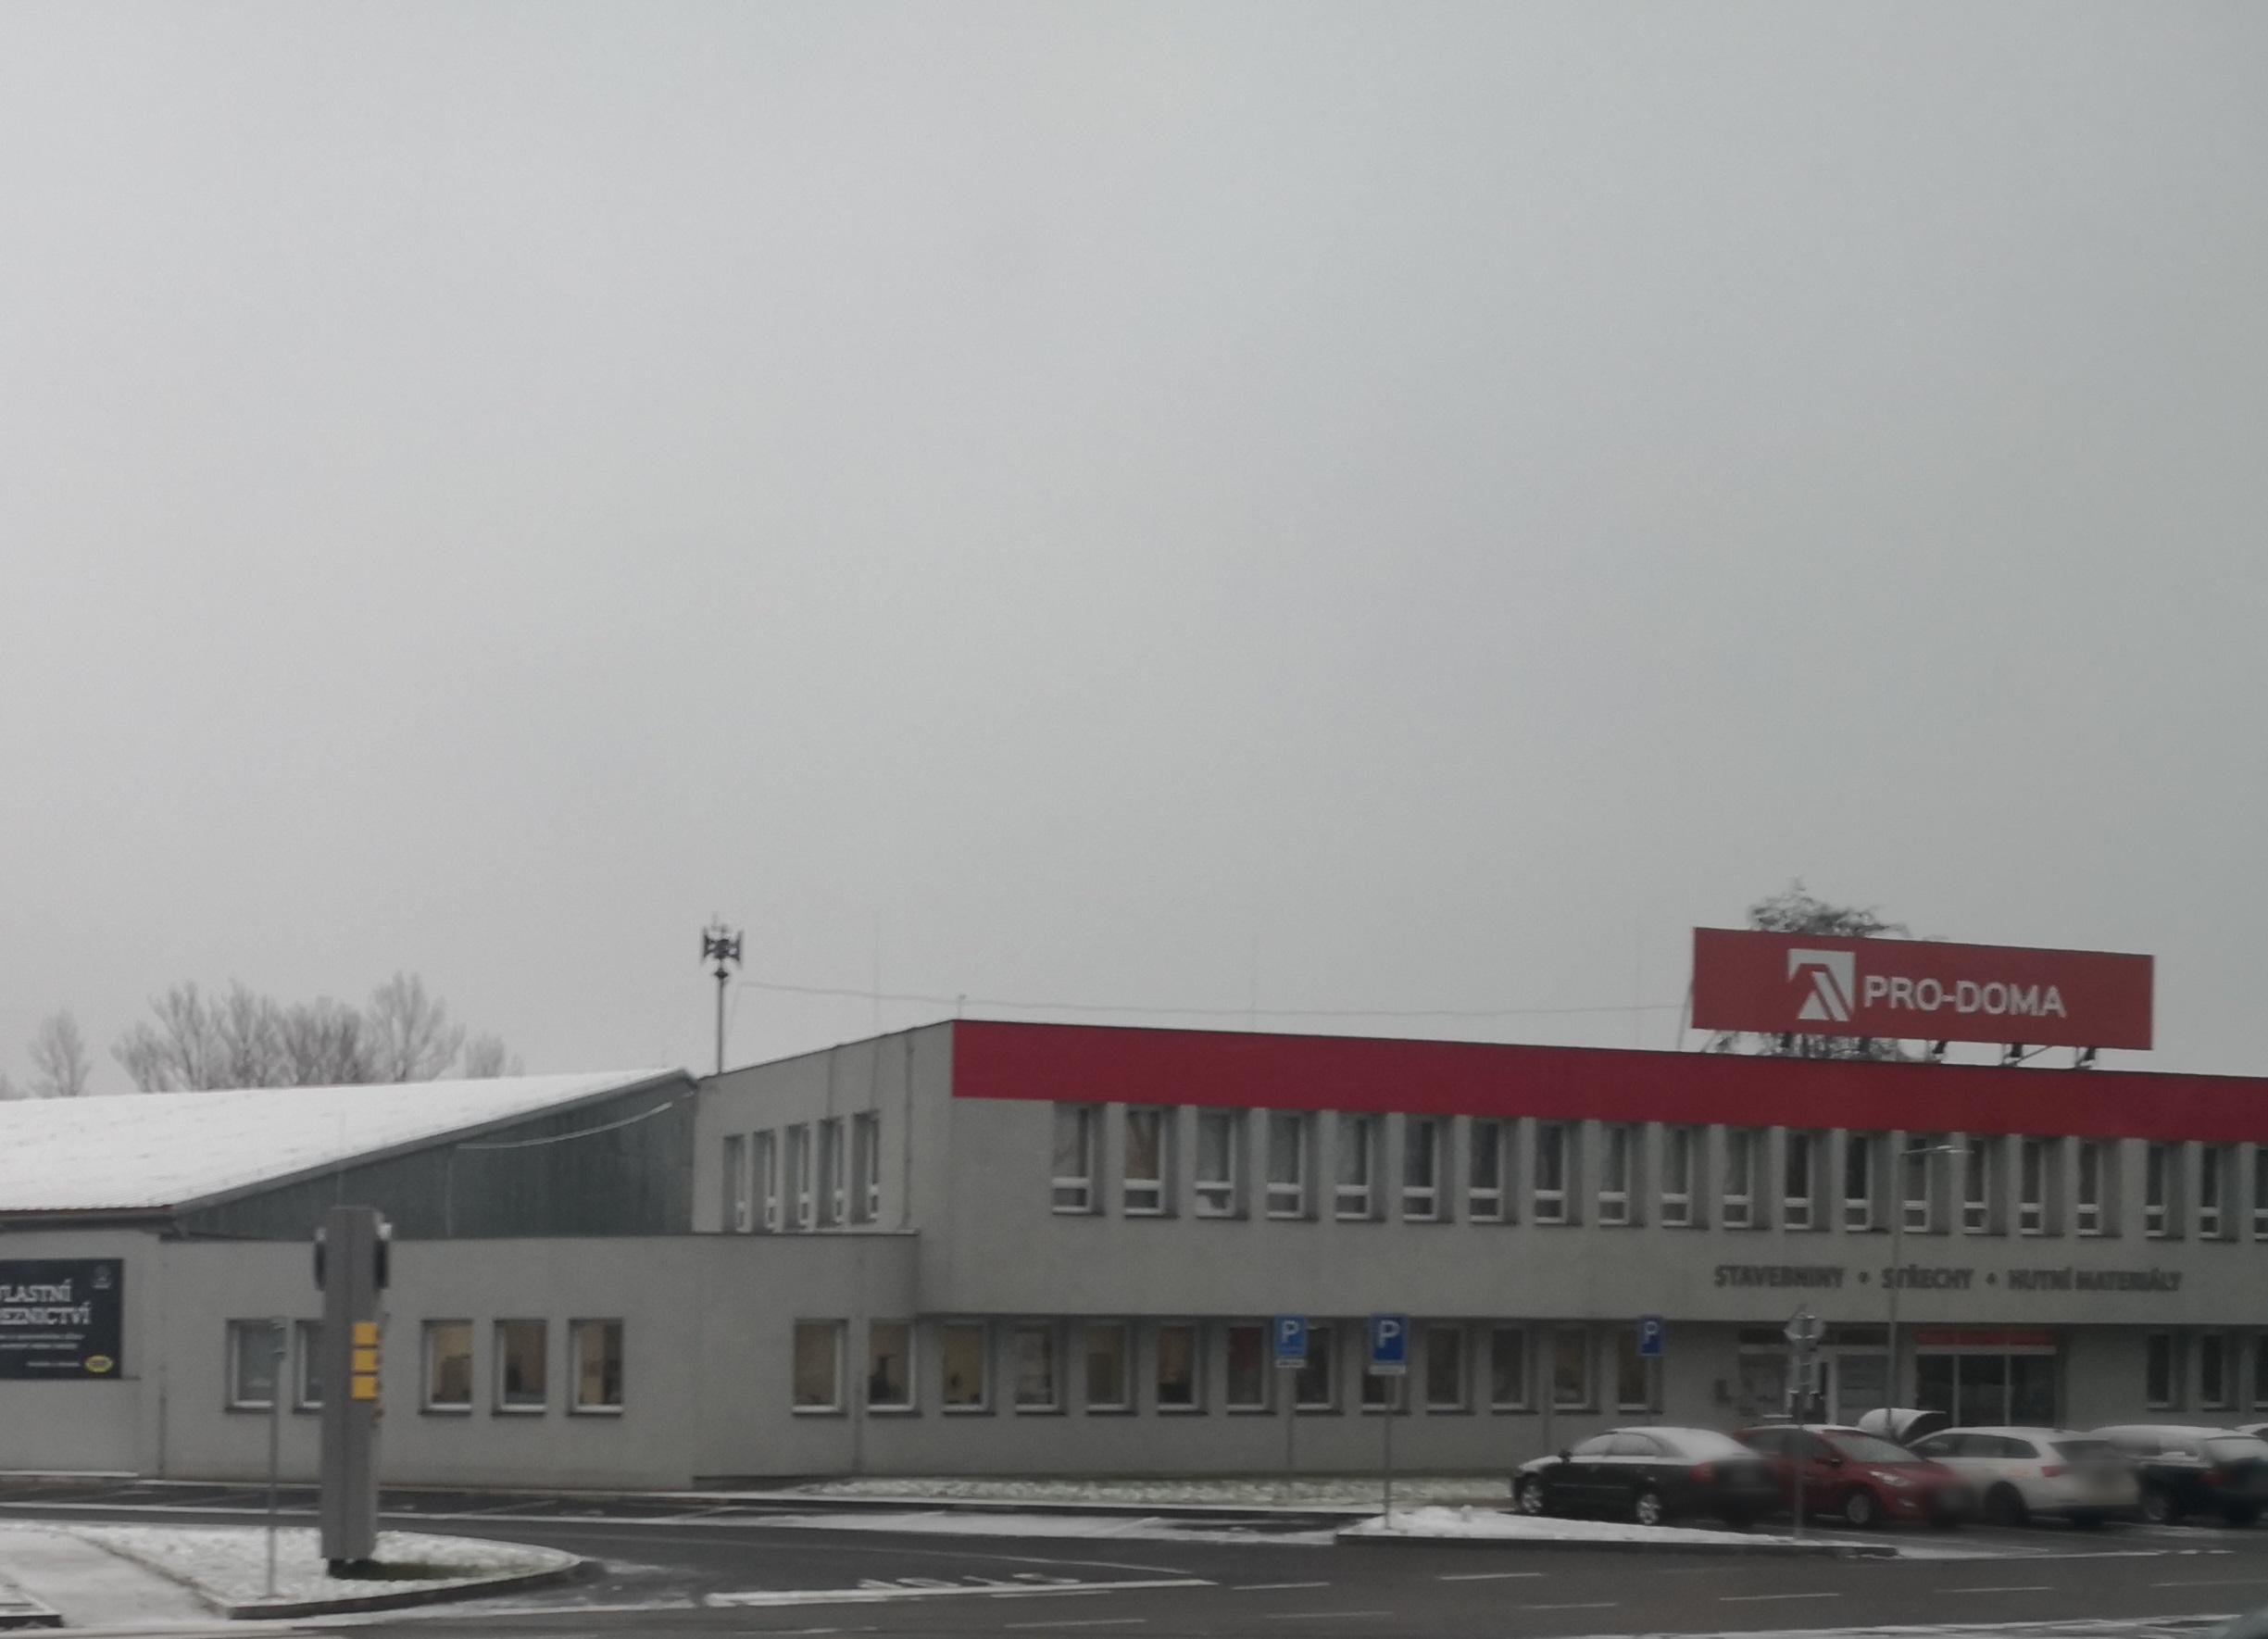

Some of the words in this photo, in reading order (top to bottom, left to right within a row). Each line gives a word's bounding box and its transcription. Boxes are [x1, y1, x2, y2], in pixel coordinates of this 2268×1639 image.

[1863, 974, 2067, 1019] PRO-DOMA
[1281, 1320, 1299, 1344] P
[1377, 1320, 1400, 1349] P
[1643, 1320, 1659, 1345] P
